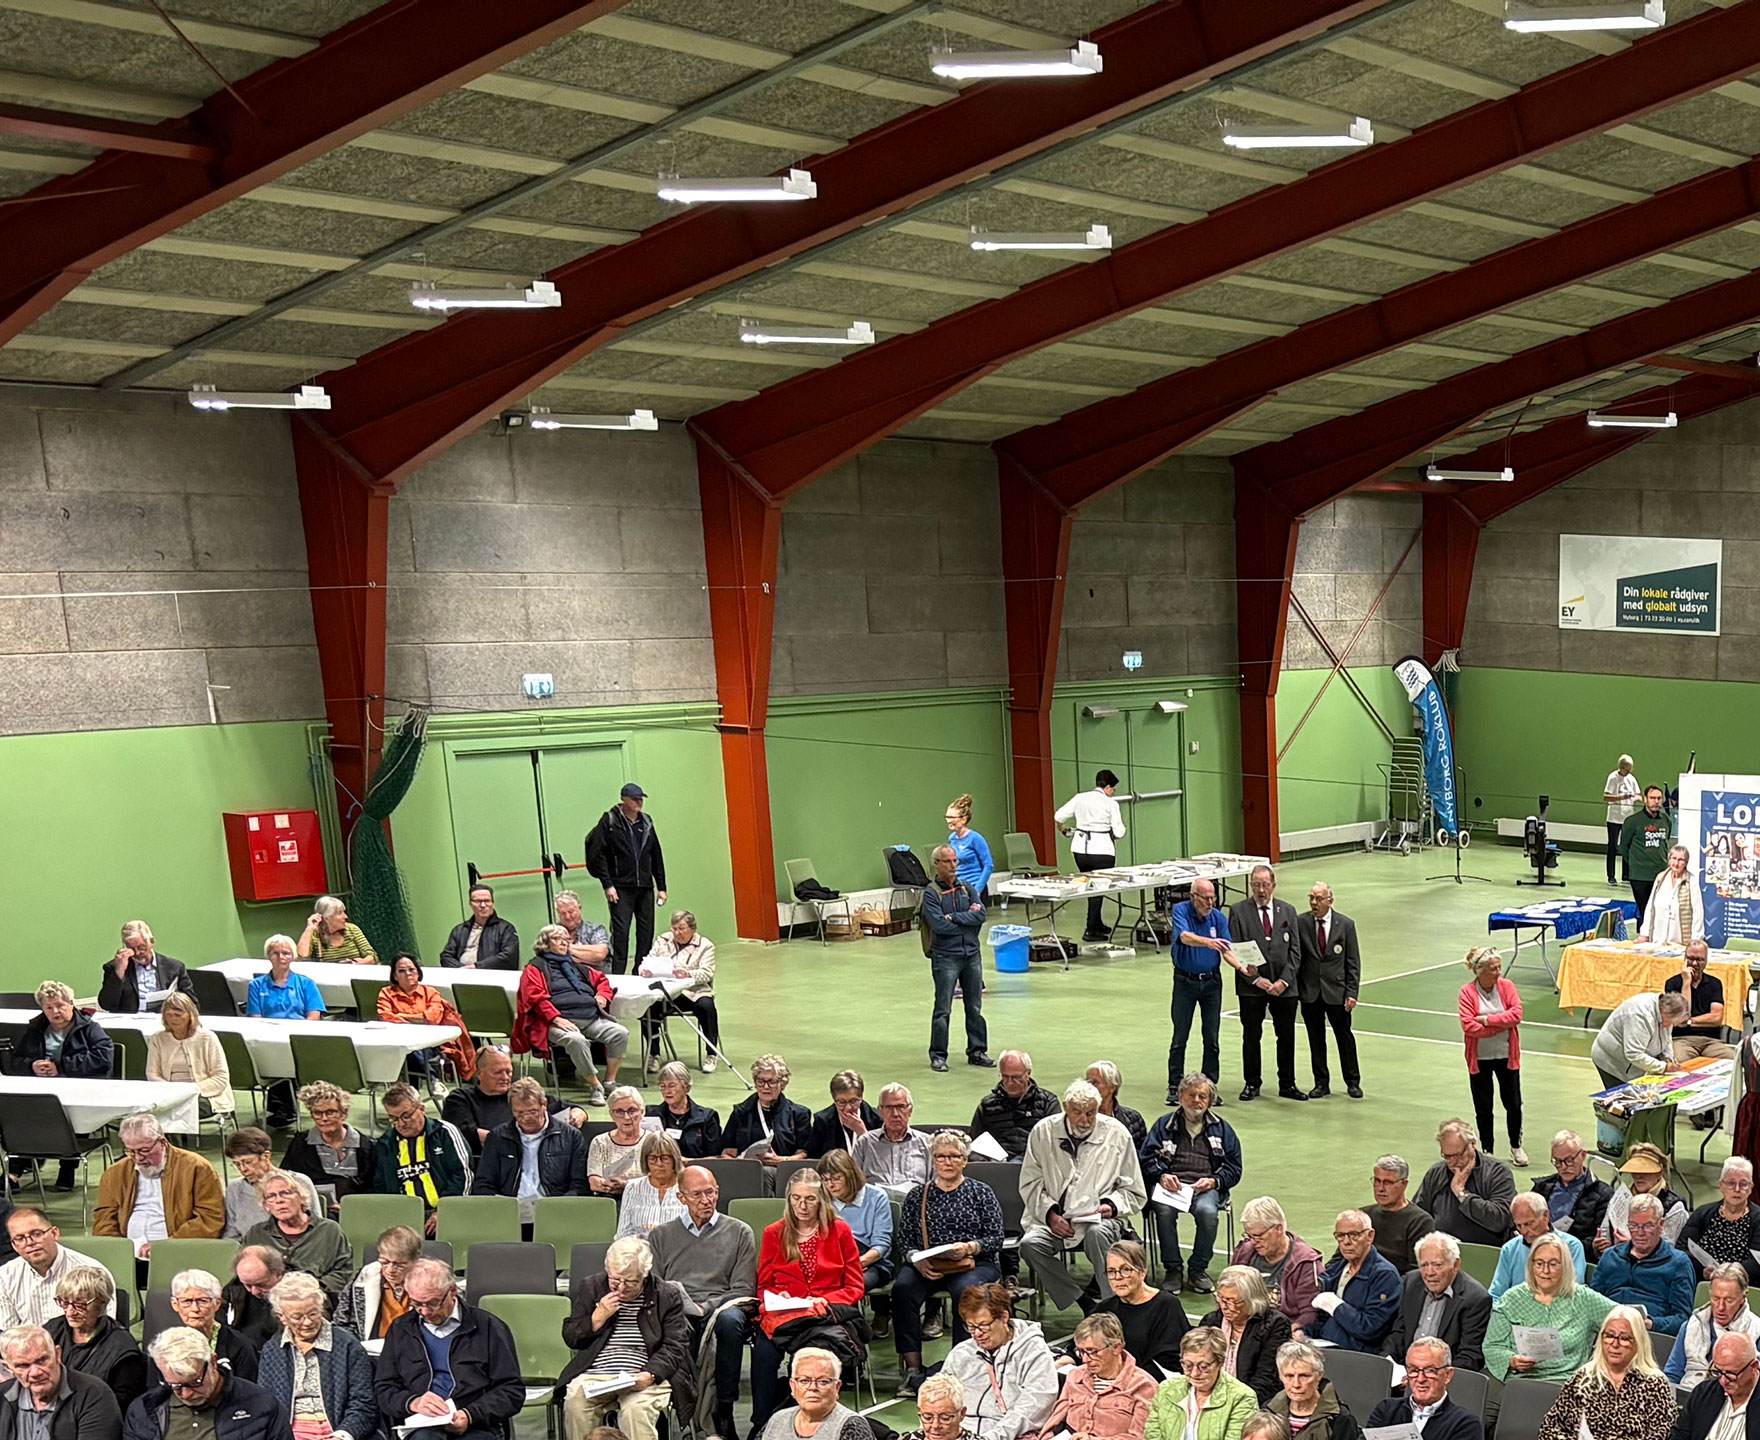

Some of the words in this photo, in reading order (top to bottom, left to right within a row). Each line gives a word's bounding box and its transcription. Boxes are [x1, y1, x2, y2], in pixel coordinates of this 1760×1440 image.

[1623, 586, 1639, 597] Din
[1641, 587, 1668, 599] lokale
[1670, 587, 1709, 601] rådgiver
[1561, 606, 1575, 617] EY
[1623, 600, 1643, 610] med
[1645, 601, 1677, 613] globalt
[1679, 602, 1708, 615] udsyn
[1428, 690, 1448, 752] ROKLUB
[1441, 755, 1454, 823] NYBORG
